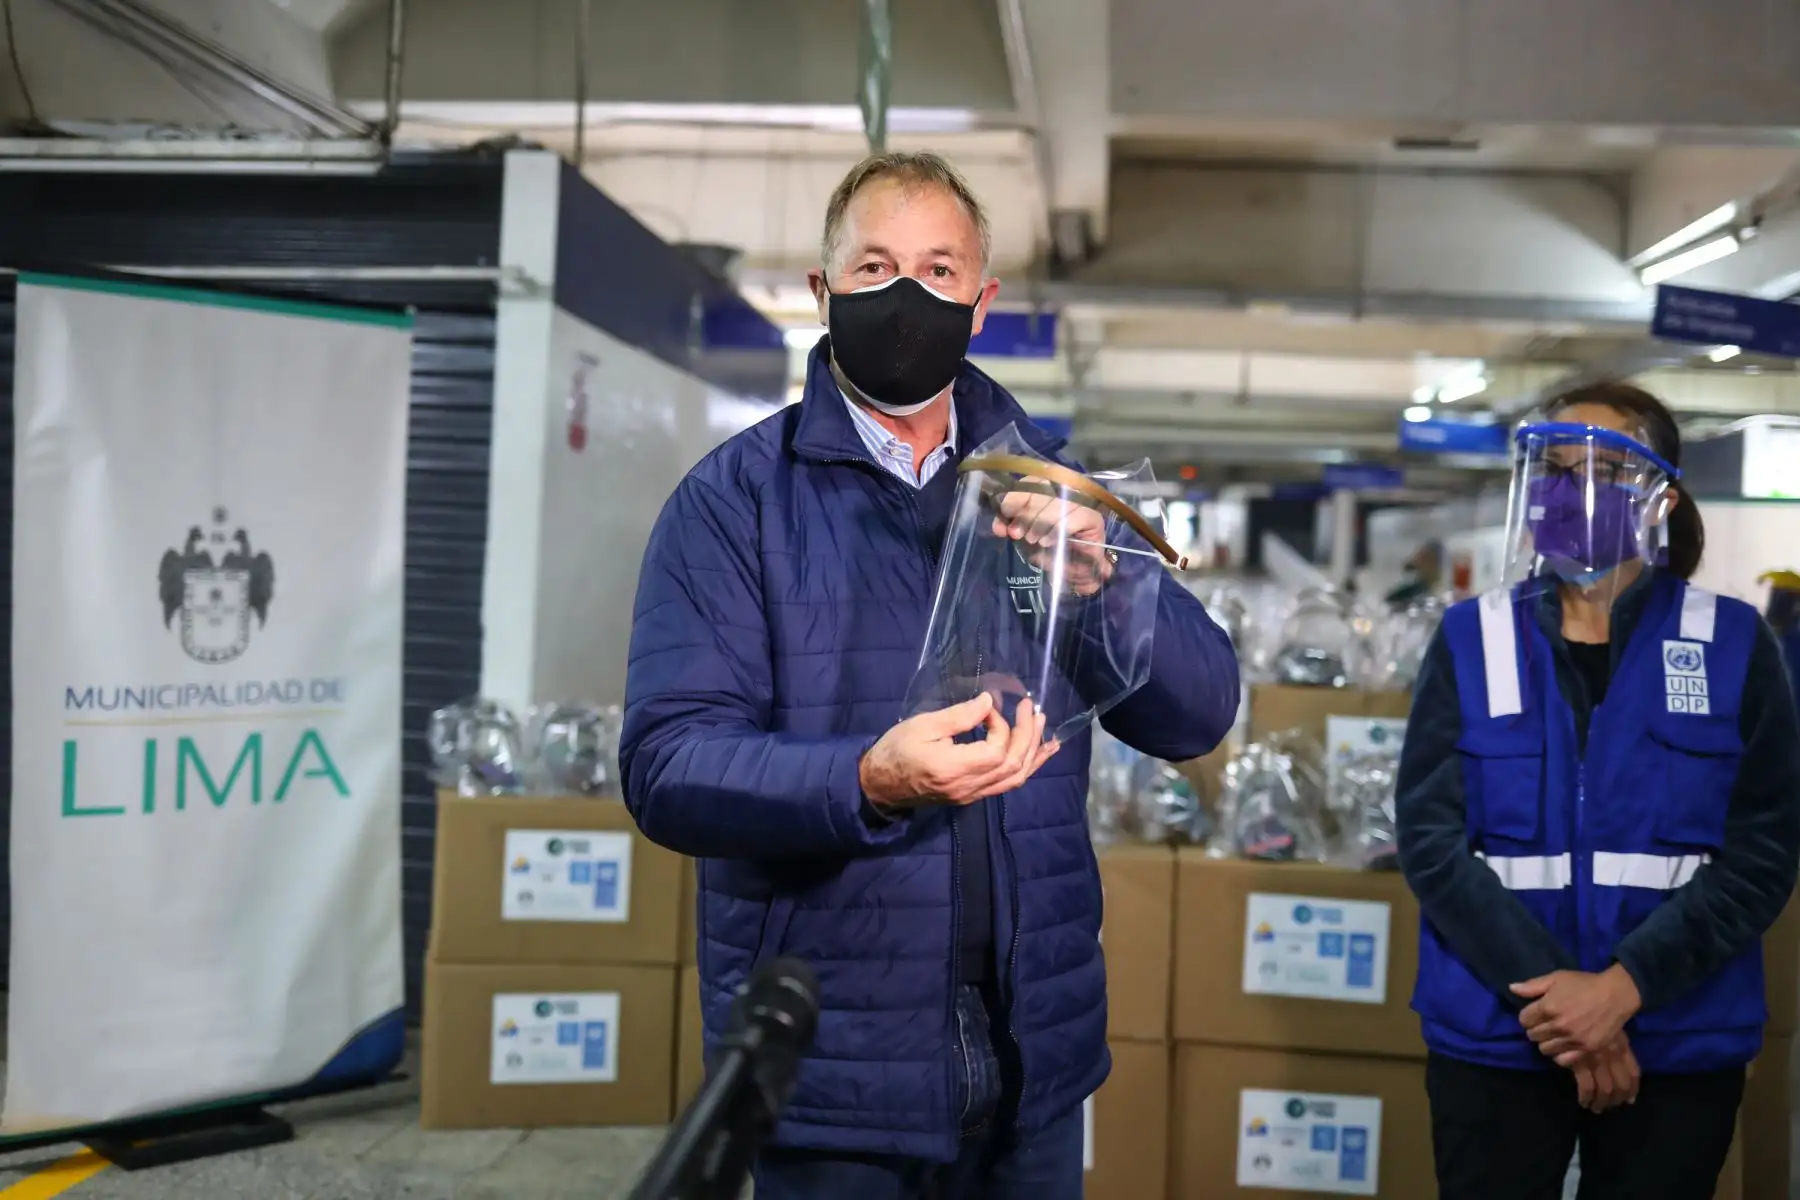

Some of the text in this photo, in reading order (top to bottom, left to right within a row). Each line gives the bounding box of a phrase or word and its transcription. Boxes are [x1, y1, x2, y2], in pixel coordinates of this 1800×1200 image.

[65, 679, 344, 710] MUNICIPALIDAD DE
[62, 729, 351, 817] LIMA
